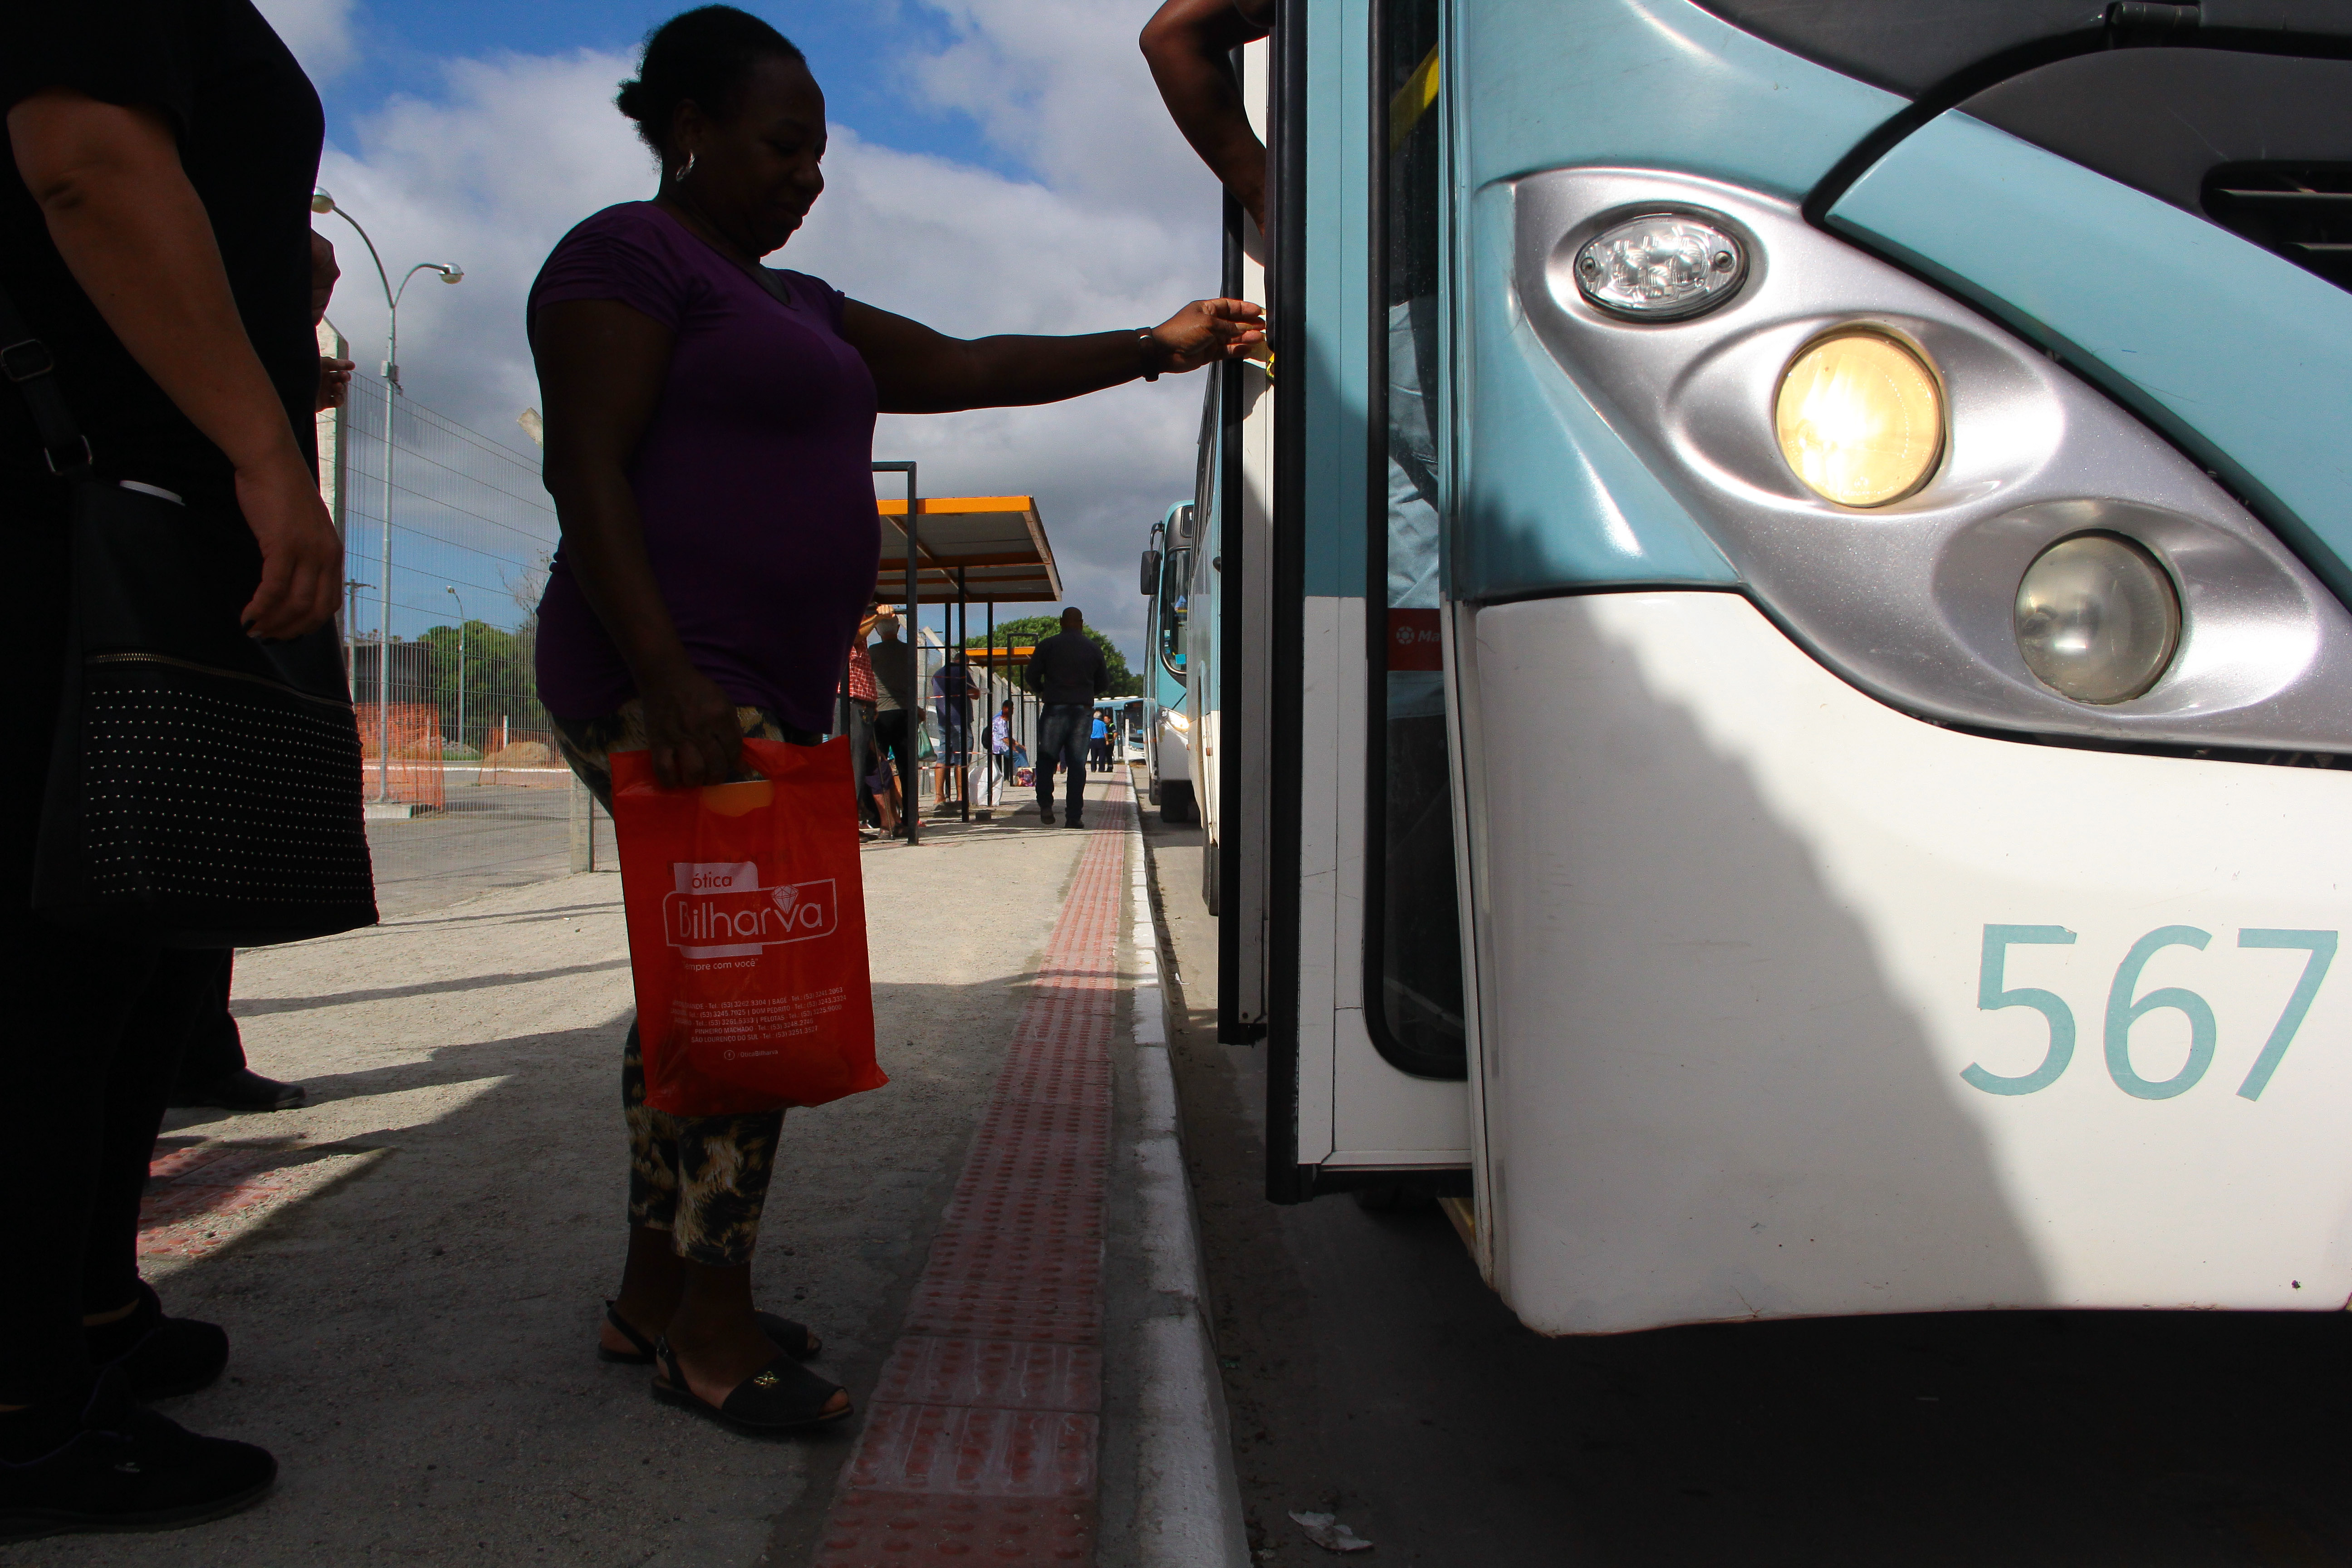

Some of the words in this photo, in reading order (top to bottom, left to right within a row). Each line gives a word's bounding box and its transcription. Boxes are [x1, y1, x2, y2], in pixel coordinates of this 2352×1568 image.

[692, 872, 732, 889] ótica
[679, 901, 823, 939] Bilharva
[772, 996, 788, 1004] BAGÉ
[815, 987, 843, 997] 3241.2063
[818, 995, 846, 1005] 3243.3324
[813, 1004, 842, 1014] 3225.9000
[1959, 923, 2338, 1102] 567
